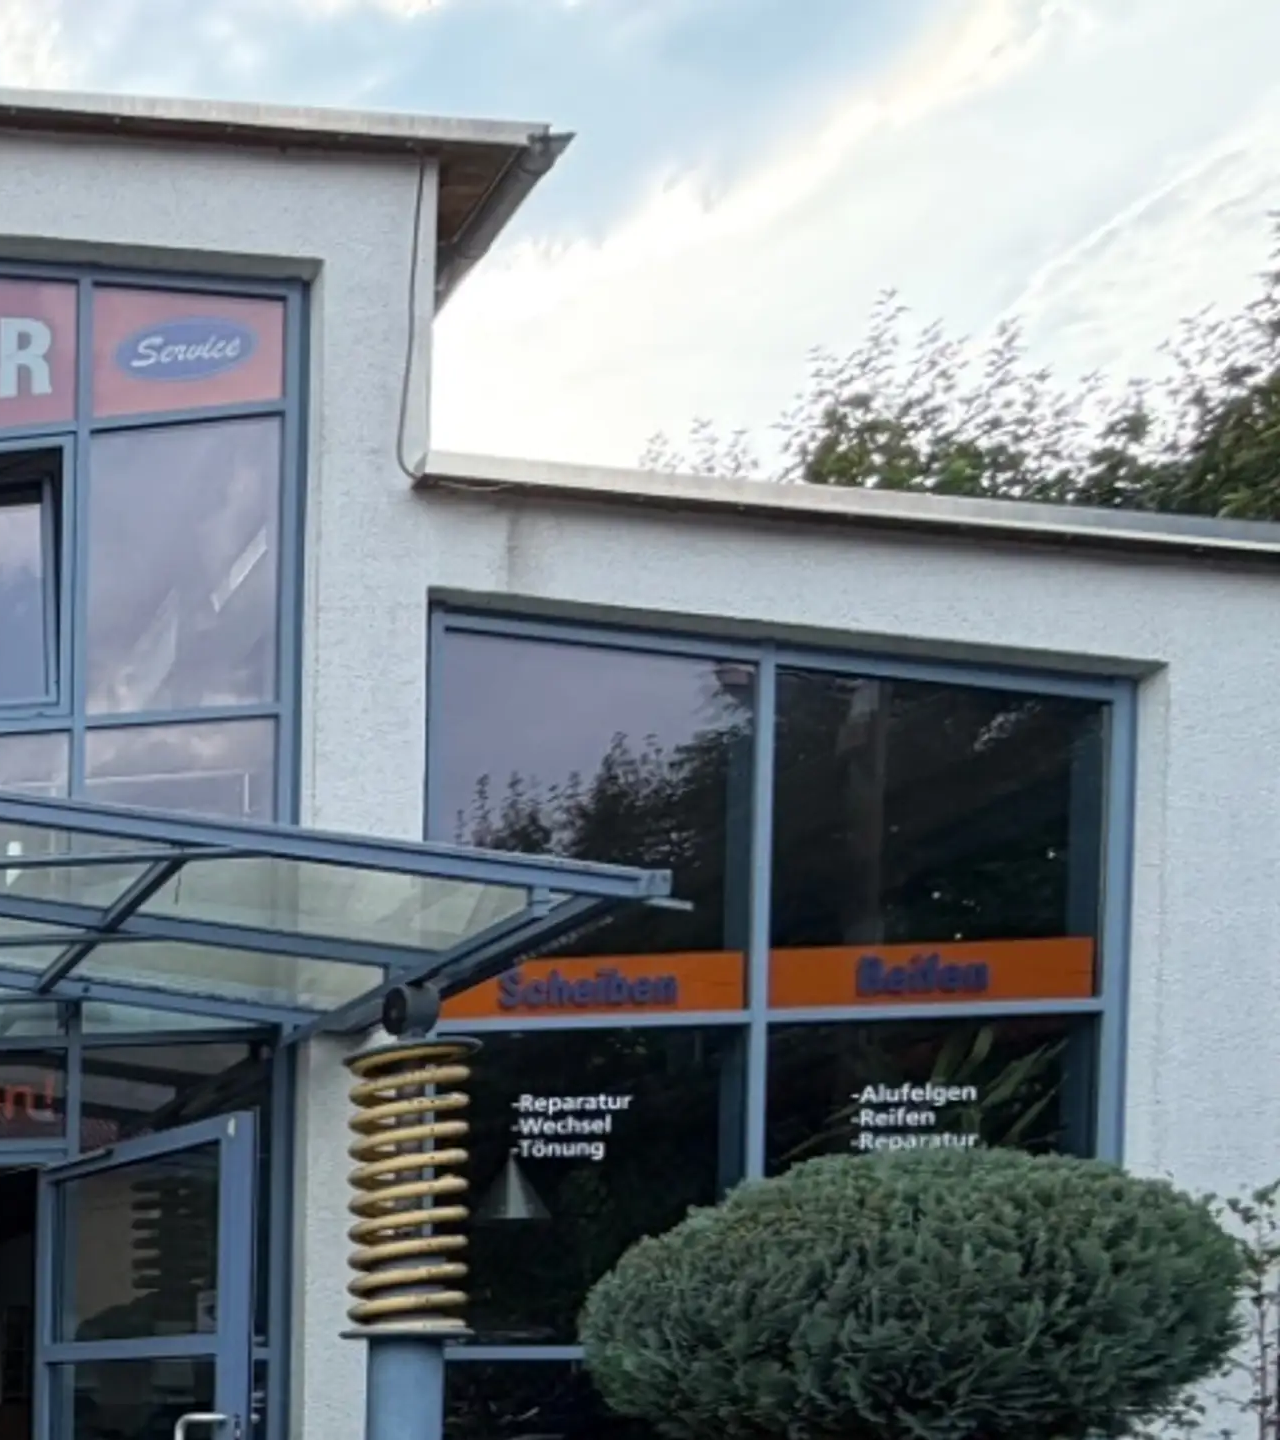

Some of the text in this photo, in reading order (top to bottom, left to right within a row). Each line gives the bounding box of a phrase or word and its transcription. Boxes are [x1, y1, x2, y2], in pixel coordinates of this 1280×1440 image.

[130, 335, 241, 368] Service
[857, 951, 989, 996] Reifen
[497, 968, 678, 1010] Scheiben
[510, 1094, 633, 1115] -Reparatur
[850, 1082, 978, 1107] -Alufelgen
[510, 1114, 612, 1135] -Wechsel
[850, 1106, 937, 1127] -Reifen
[509, 1139, 605, 1160] -Tönung
[850, 1131, 980, 1152] -Reparatur
